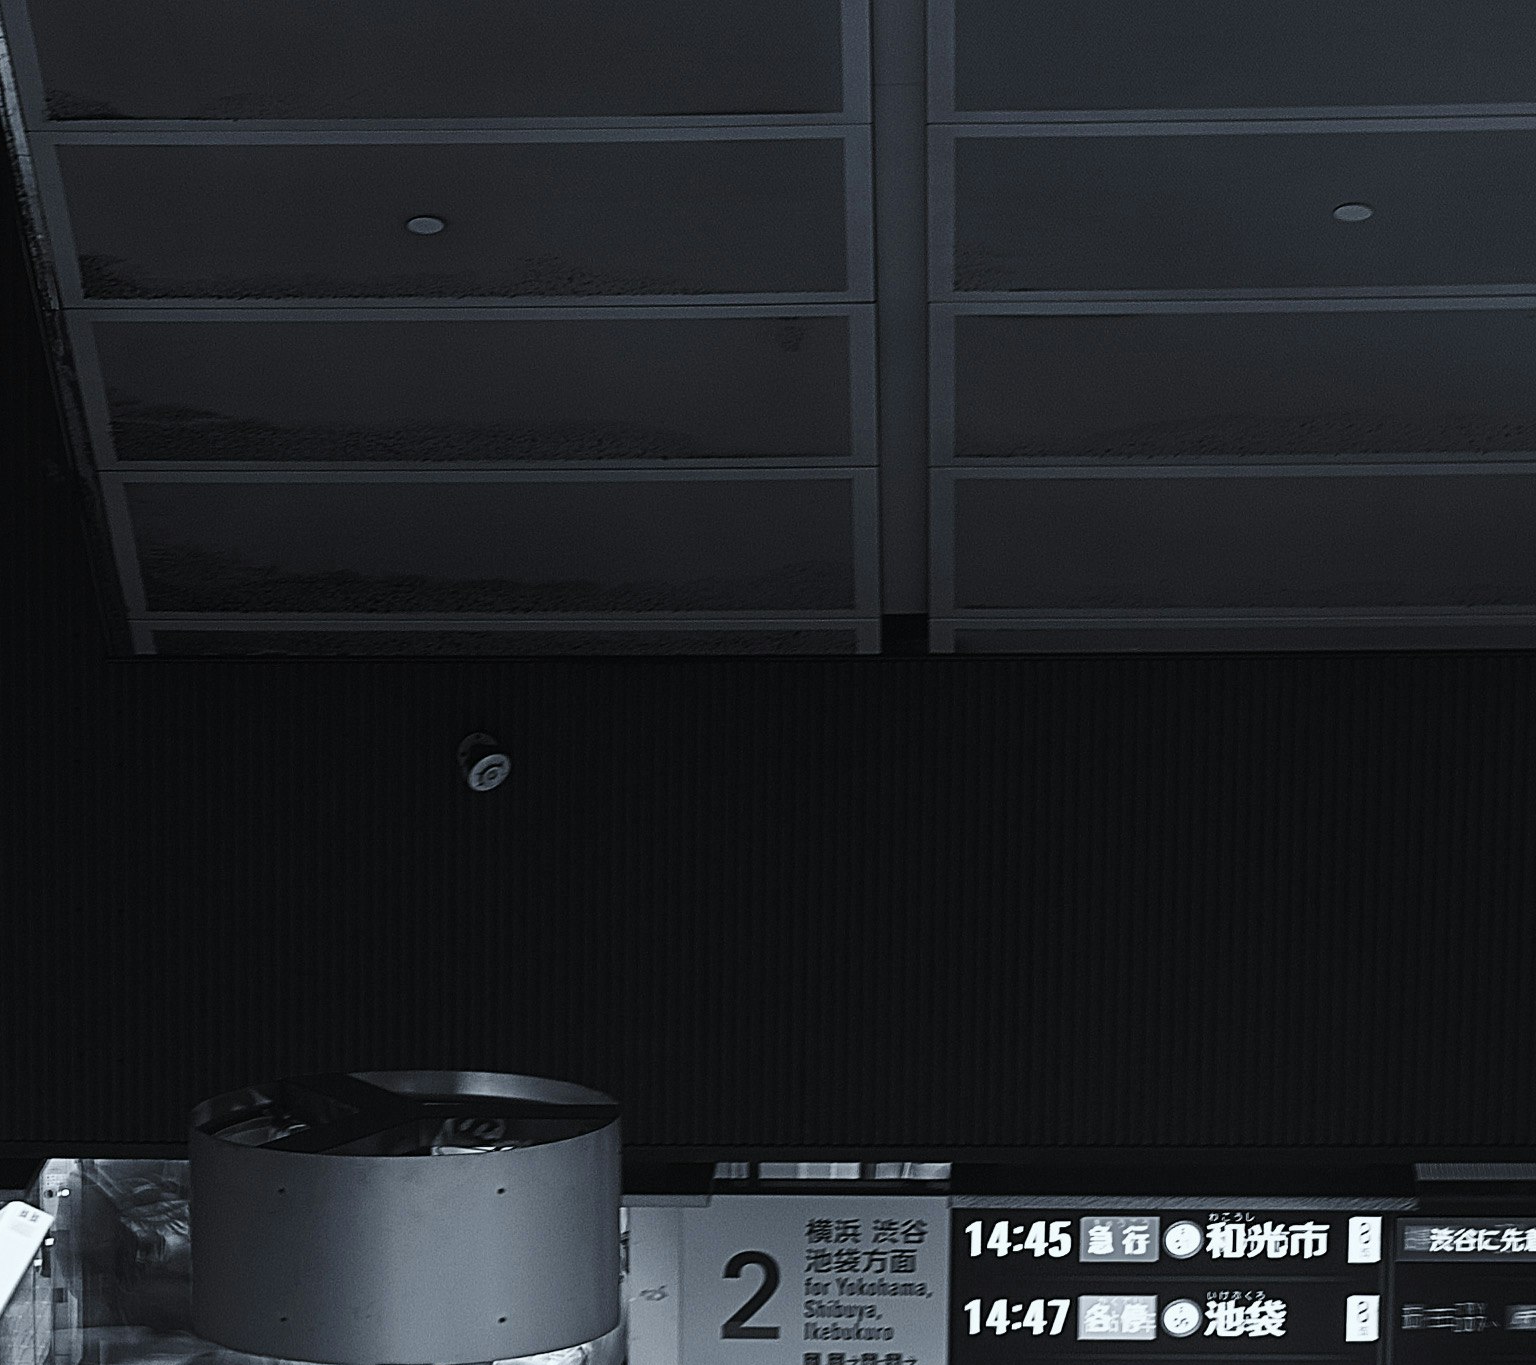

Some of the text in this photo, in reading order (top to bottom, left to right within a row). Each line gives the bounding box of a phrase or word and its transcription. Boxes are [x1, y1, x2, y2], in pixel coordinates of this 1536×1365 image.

[804, 1219, 929, 1245] 横浜 渋谷
[965, 1220, 1072, 1258] 14:45
[1087, 1224, 1151, 1255] 急行
[1205, 1221, 1330, 1259] 和光市
[803, 1248, 918, 1274] 池袋方面
[721, 1250, 781, 1340] 2
[803, 1277, 933, 1300] for Yokohama,
[802, 1300, 883, 1322] Shibuya,
[964, 1298, 1071, 1336] 14:47
[1203, 1300, 1287, 1337] 池袋
[803, 1322, 895, 1342] Ikebukuro
